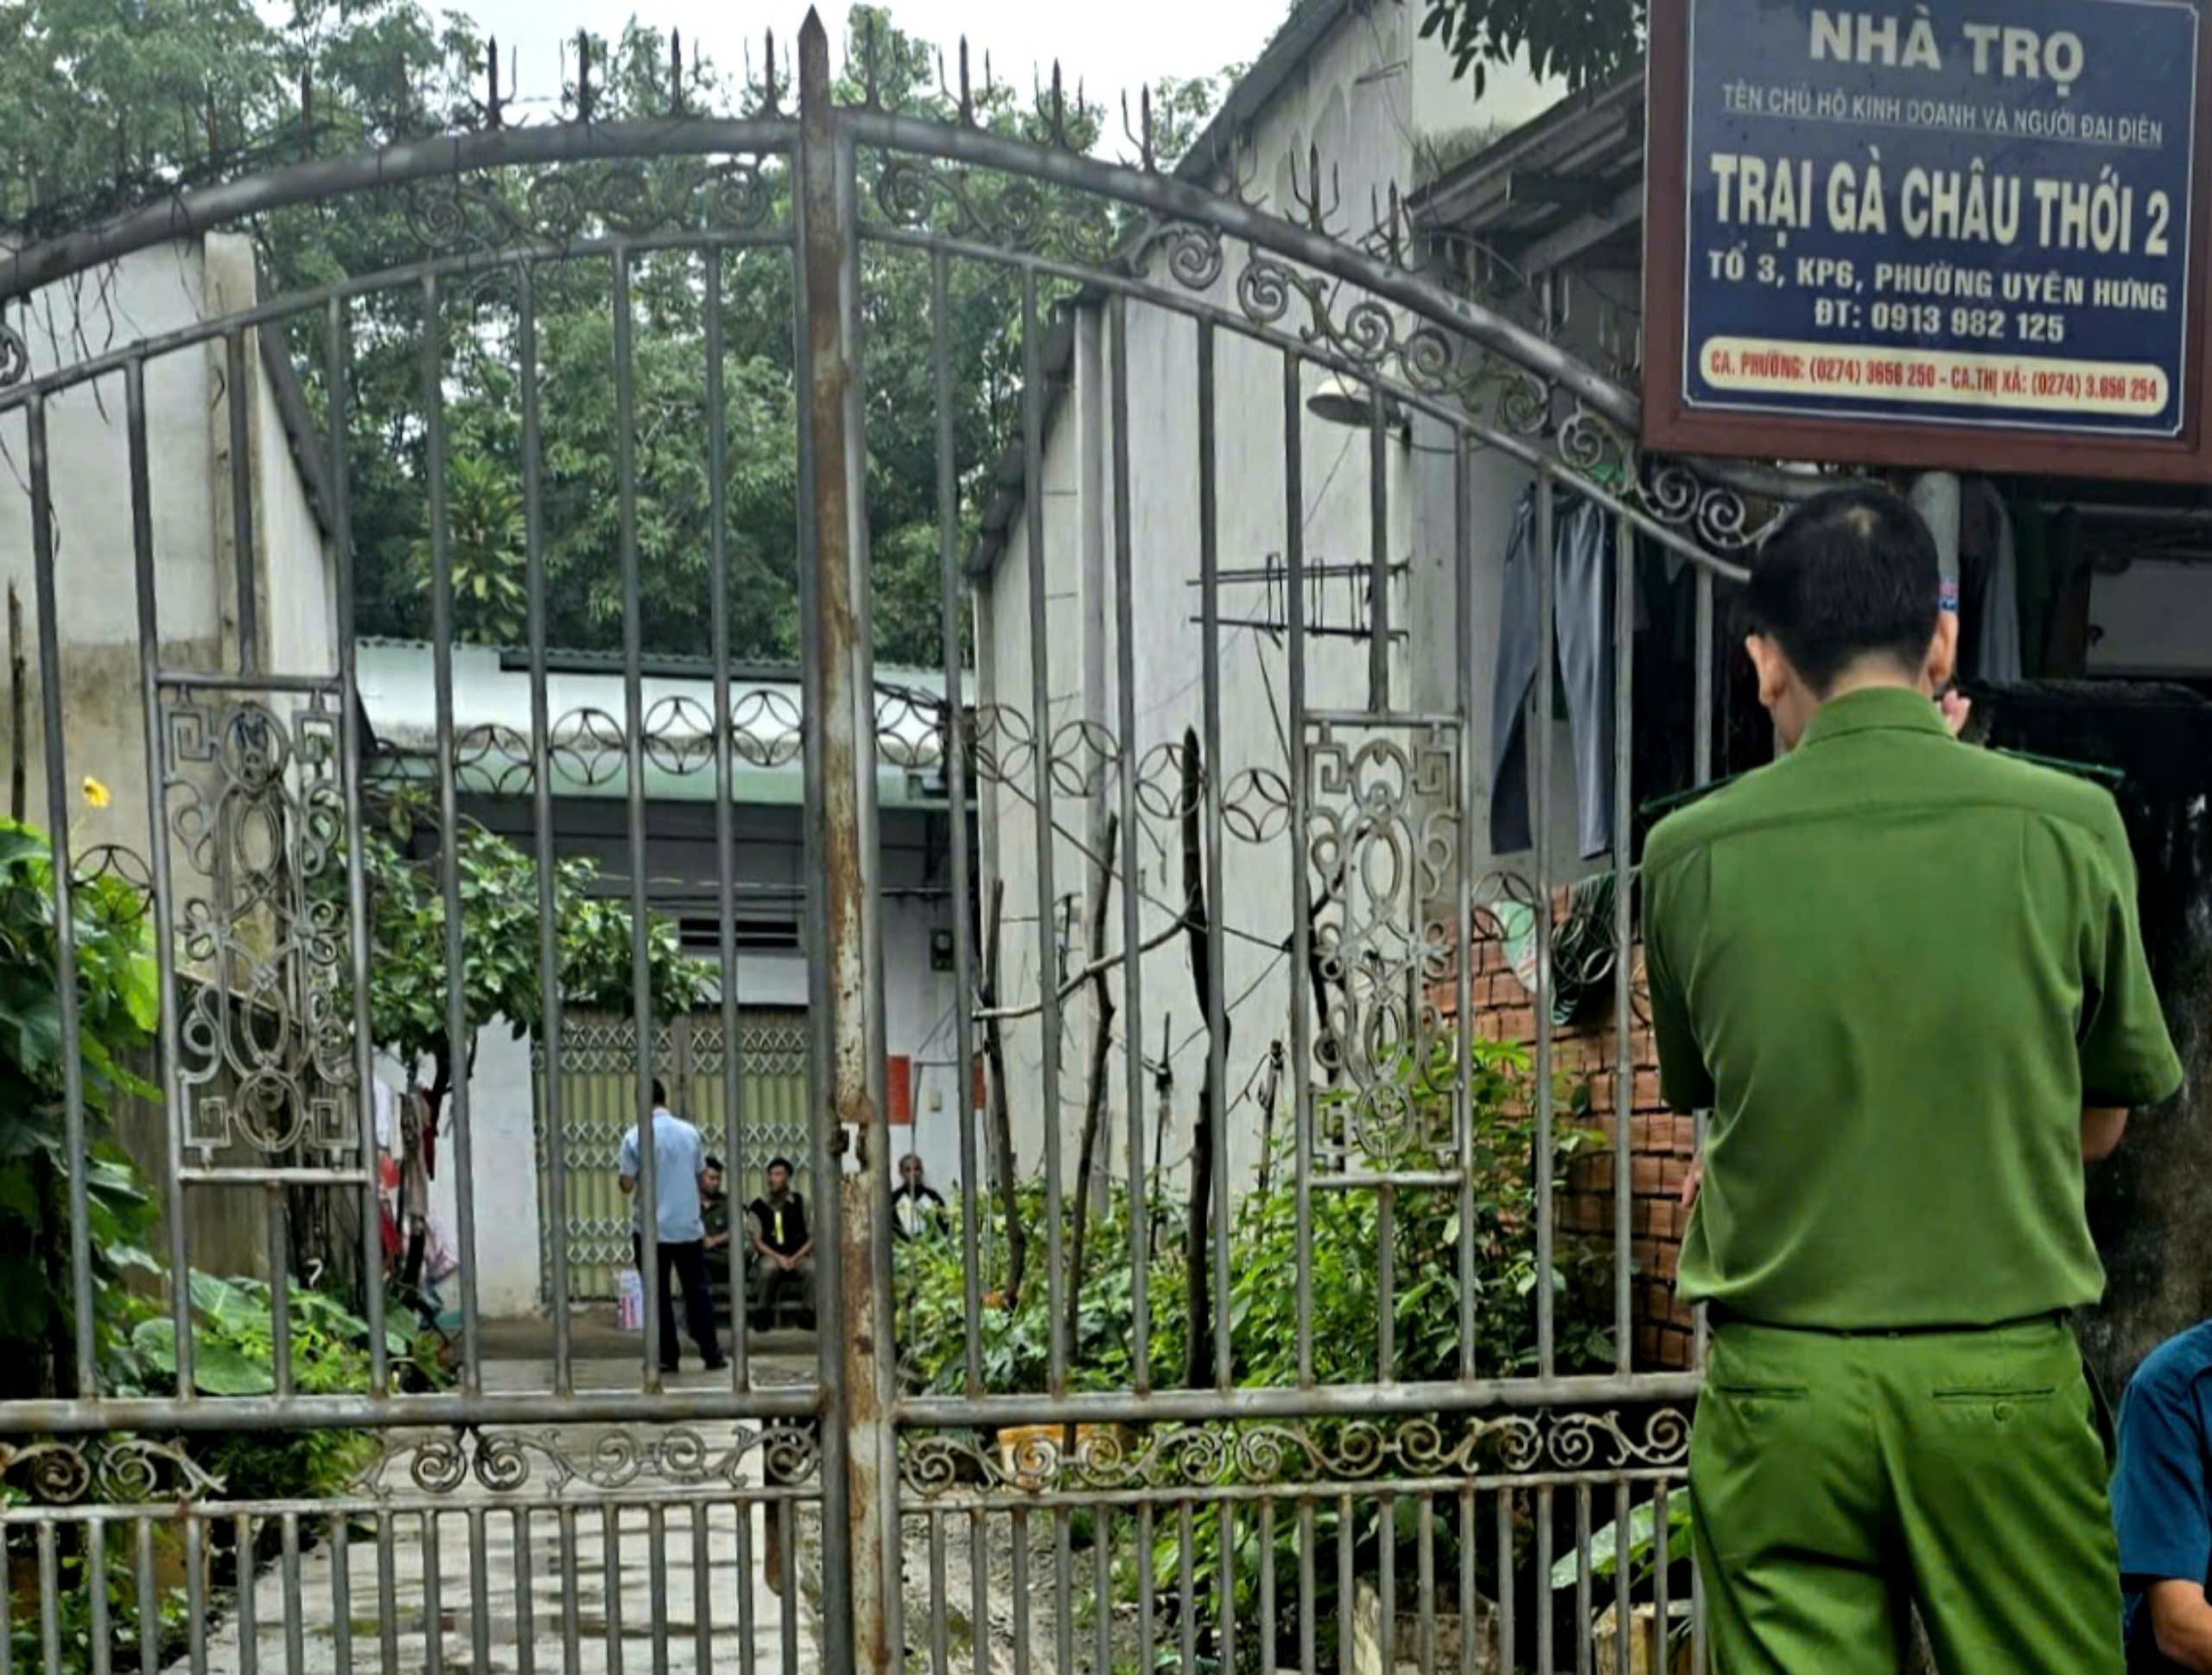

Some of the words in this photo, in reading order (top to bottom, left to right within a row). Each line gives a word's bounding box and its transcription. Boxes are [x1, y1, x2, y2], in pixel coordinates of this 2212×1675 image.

[1808, 4, 1943, 72] NHÀ
[1962, 22, 2085, 98] TRỌ
[1721, 79, 1763, 111] TÊN
[1853, 94, 1901, 123] KINH
[1907, 99, 1976, 129] DOANH
[1982, 99, 2008, 132] VÀ
[2013, 106, 2075, 137] NGƯỜI
[1710, 153, 1813, 248] TRẠI
[1827, 144, 1887, 235] GÀ
[1901, 156, 2020, 245] CHÂU
[2033, 163, 2133, 254] THỚI
[2144, 188, 2171, 256] 2
[1707, 239, 1748, 281] TỔ
[1757, 253, 1785, 289] 3,
[1796, 258, 1863, 294] KP6,
[1874, 258, 1993, 298] PHƯỜNG
[2002, 270, 2084, 305] UYÊN
[2093, 277, 2168, 311] HƯNG
[1815, 298, 1861, 328] ĐT:
[1871, 303, 1942, 334] 0913
[1950, 308, 2005, 338] 982
[2016, 312, 2065, 343] 125
[1809, 355, 1861, 385] (0274)
[2031, 371, 2082, 399] (0274)
